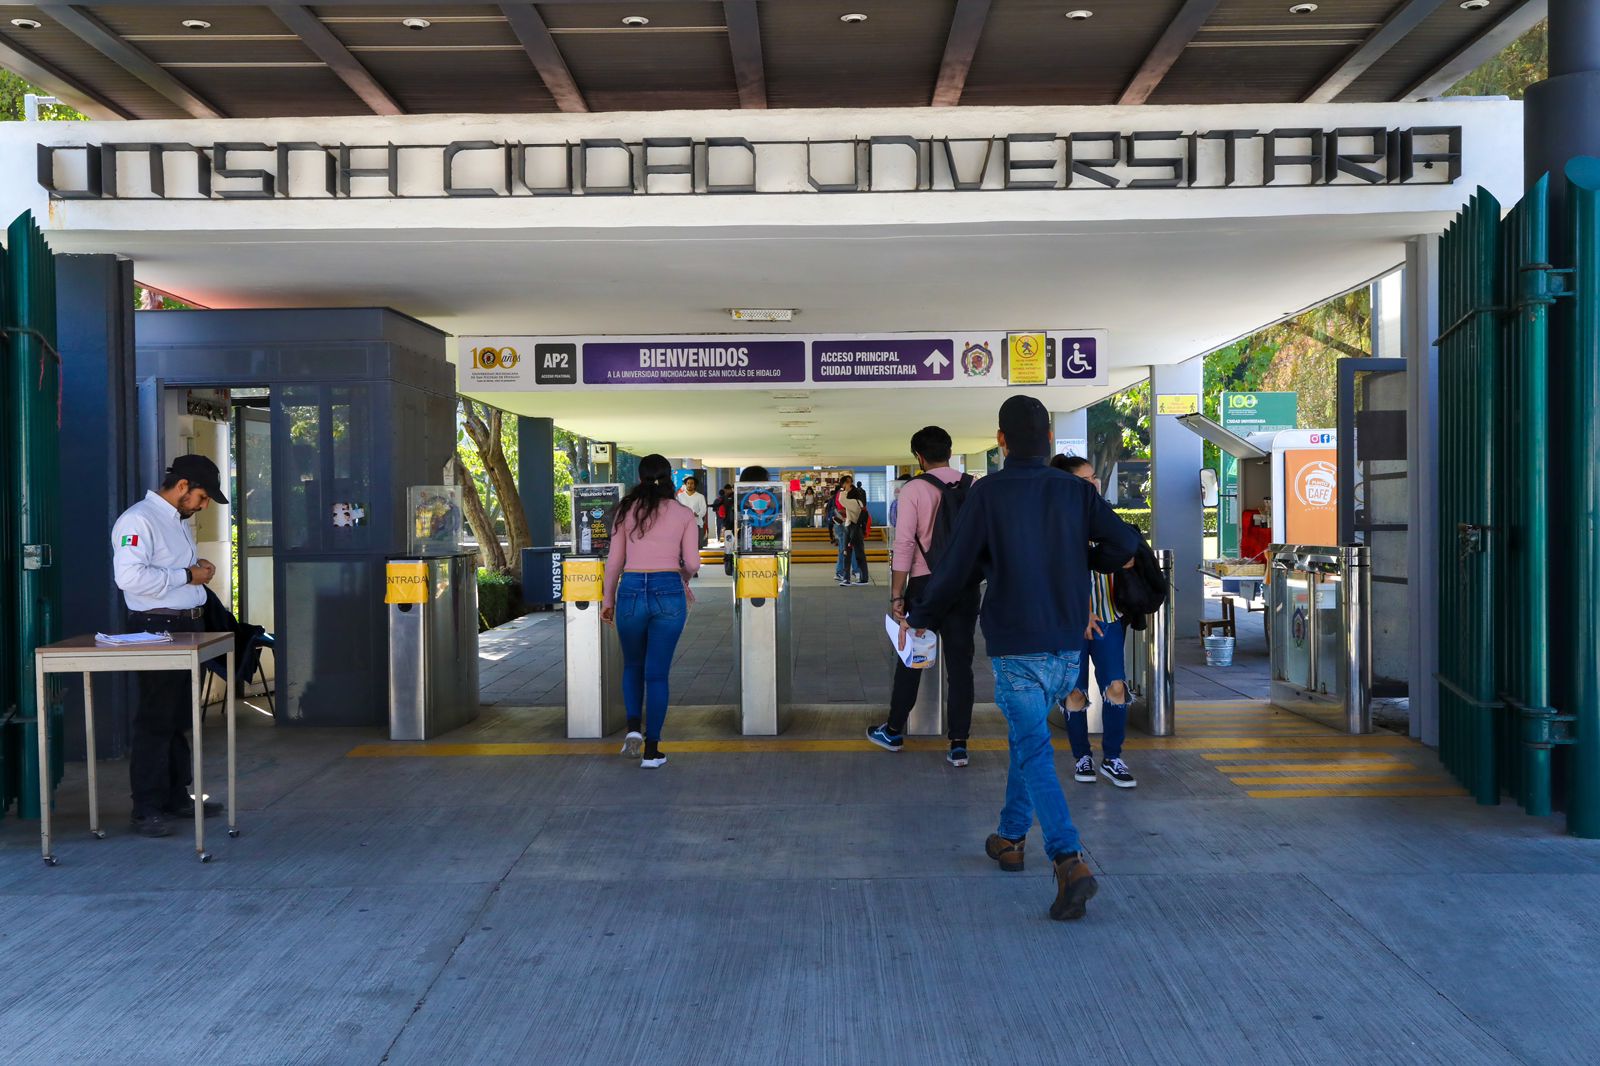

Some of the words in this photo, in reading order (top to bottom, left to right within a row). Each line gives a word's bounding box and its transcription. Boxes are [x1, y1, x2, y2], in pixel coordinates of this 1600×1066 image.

[443, 137, 758, 197] CIUDAD
[807, 125, 1463, 193] UNIVERSITARIA
[470, 346, 517, 370] 100
[543, 353, 569, 368] AP2
[639, 347, 749, 368] BIENVENIDOS
[820, 352, 854, 362] ACCESO
[855, 351, 900, 362] PRINCIPAL
[621, 370, 659, 378] UNIVERSIDAD
[660, 370, 698, 378] MICHOACANA
[747, 369, 755, 377] DE
[755, 369, 781, 377] HIDALGO
[820, 366, 852, 376] CIUDAD
[854, 364, 917, 375] UNIVERSITARIA
[387, 575, 426, 584] NTRADA
[551, 552, 562, 599] BASURA
[563, 574, 602, 583] NTRADA
[738, 570, 778, 579] NTRADA
